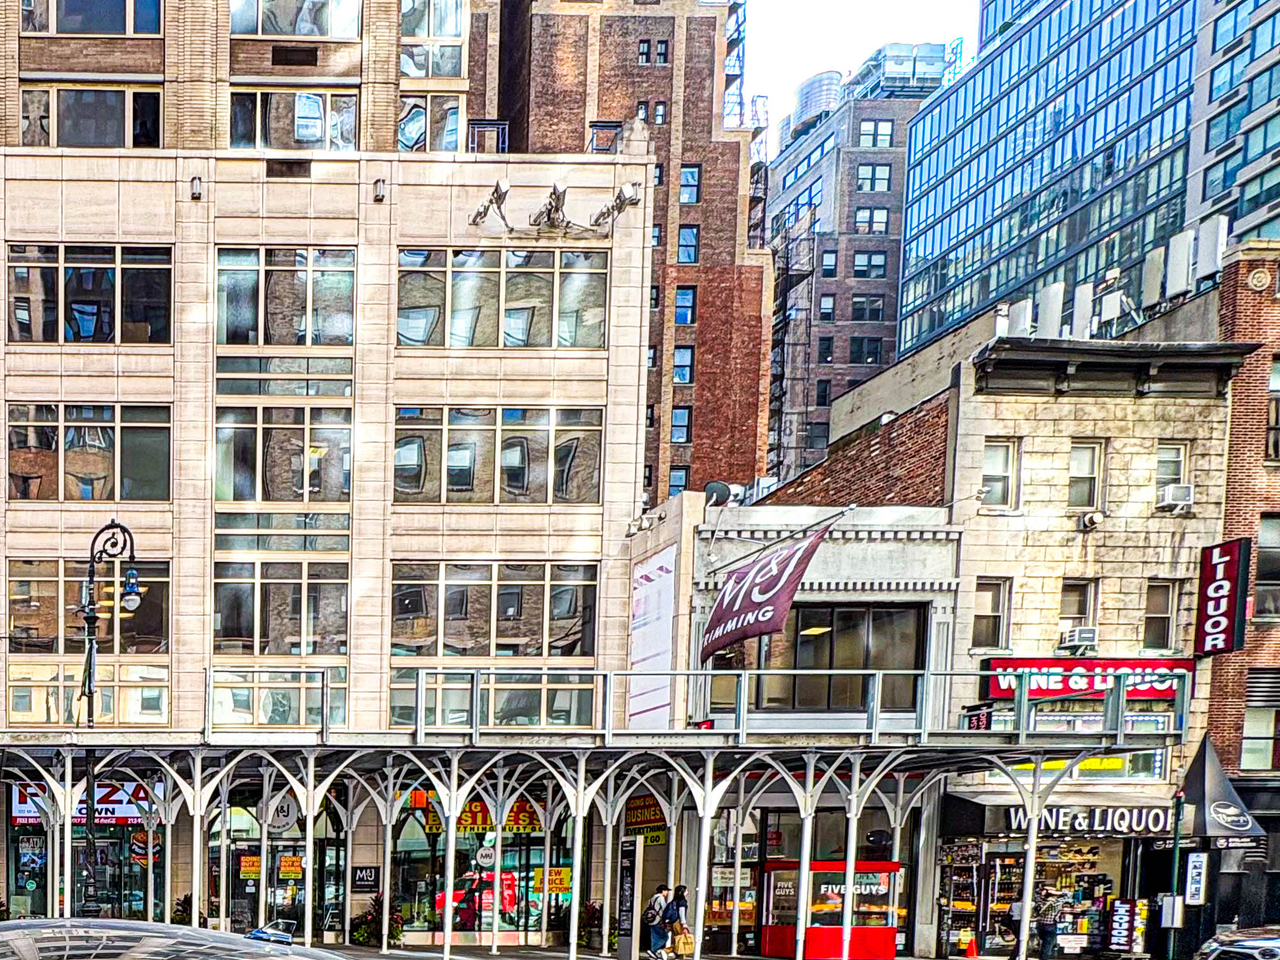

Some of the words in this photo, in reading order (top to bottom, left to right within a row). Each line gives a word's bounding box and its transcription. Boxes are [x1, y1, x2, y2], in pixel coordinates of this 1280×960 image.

[711, 537, 812, 612] M&J
[1204, 547, 1231, 652] LIQUOR
[996, 667, 1064, 690] WNE
[1068, 666, 1089, 690] &
[18, 782, 157, 805] PZA
[626, 823, 666, 836] EVERYTHING
[1009, 807, 1071, 832] WNE
[1074, 811, 1090, 831] &
[650, 834, 661, 844] GO
[355, 868, 375, 881] M&J
[775, 888, 795, 896] GUYS
[820, 884, 847, 895] FIVE
[853, 884, 888, 895] GUYS
[1108, 900, 1131, 950] LIQUOR
